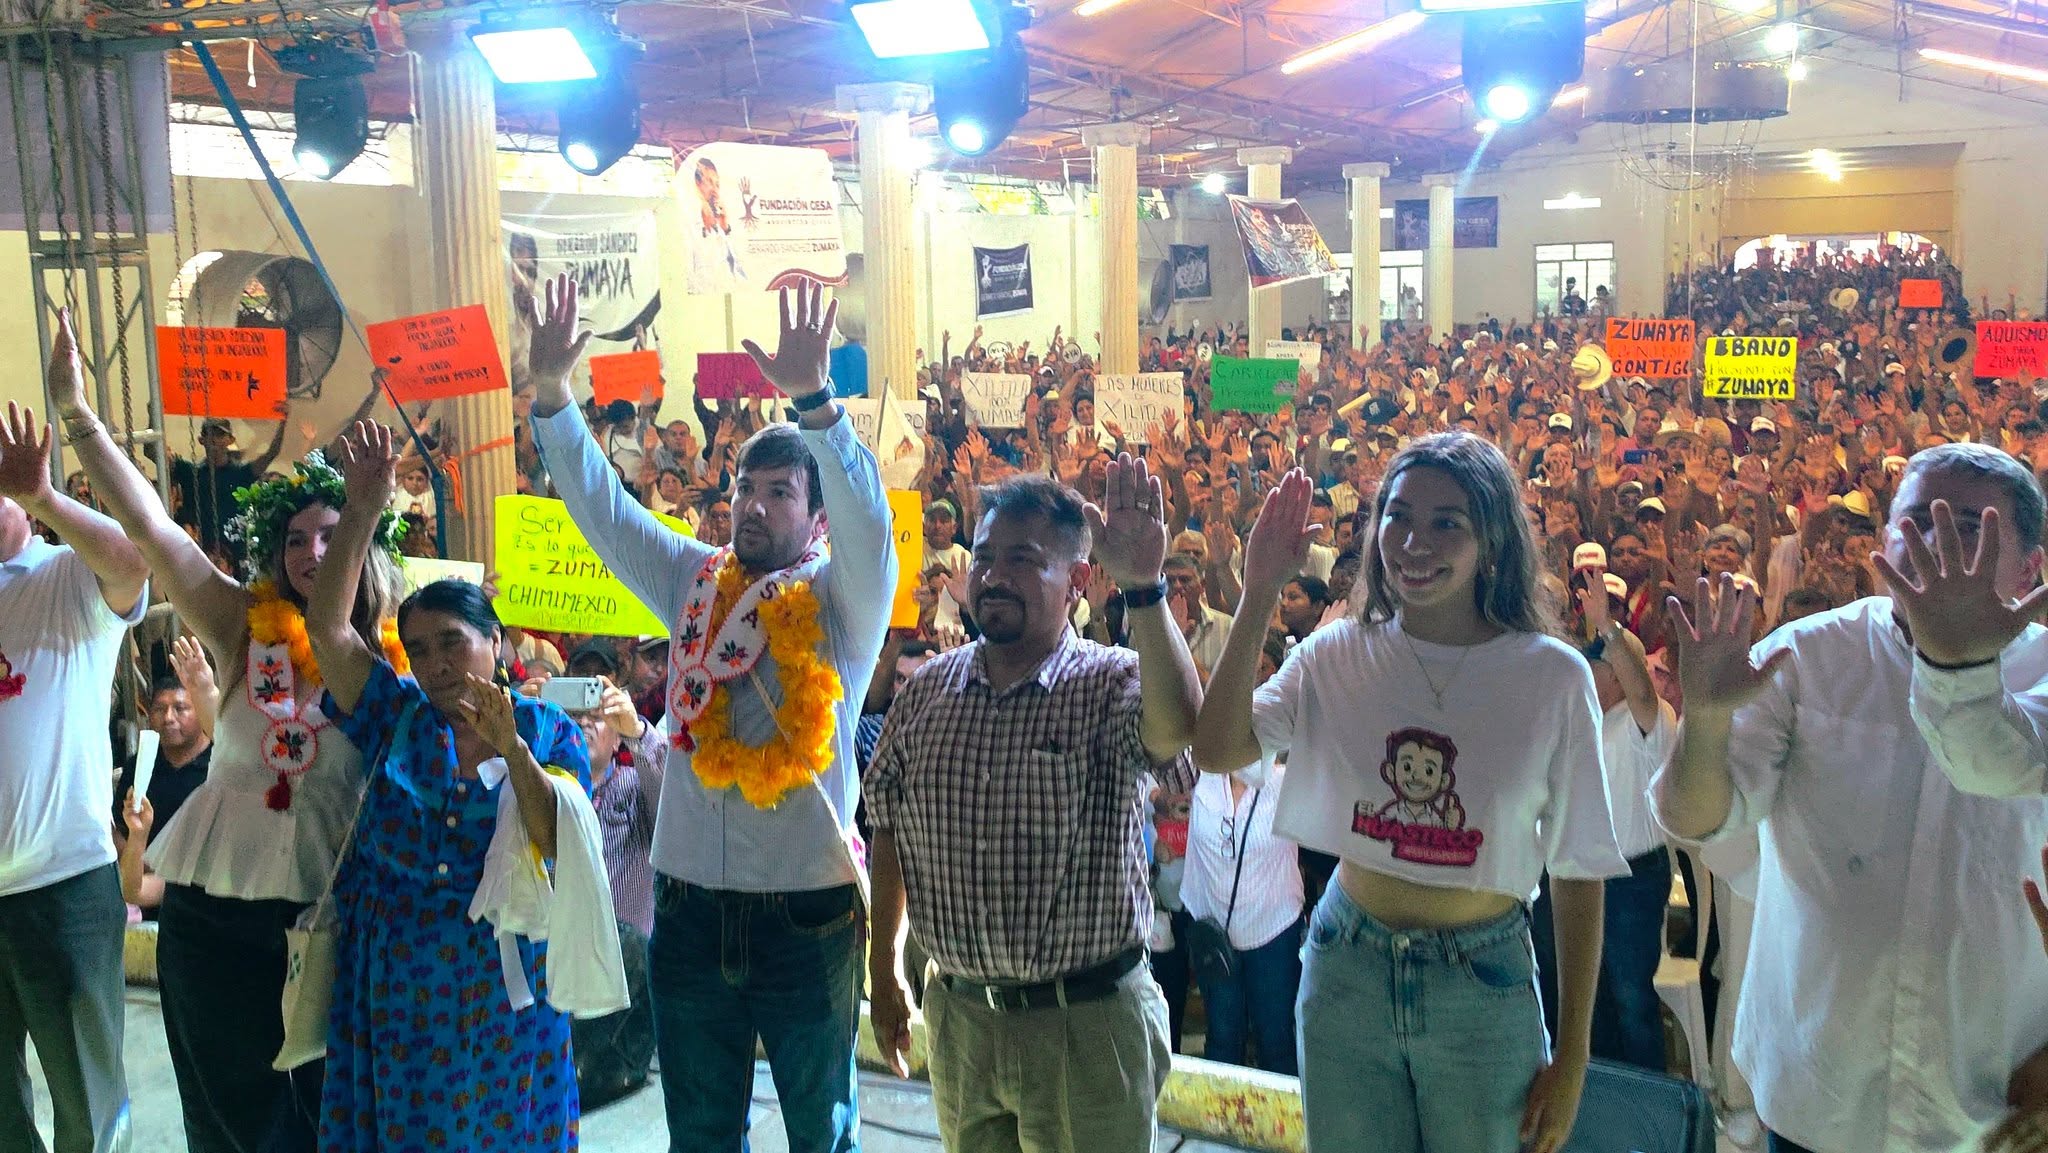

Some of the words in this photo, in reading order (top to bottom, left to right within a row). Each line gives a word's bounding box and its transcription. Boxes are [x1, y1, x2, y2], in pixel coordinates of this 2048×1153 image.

[759, 197, 808, 211] FUNDACIÓN
[810, 201, 833, 211] CESA
[1611, 319, 1690, 342] ZUMAYA
[520, 505, 564, 535] Ser
